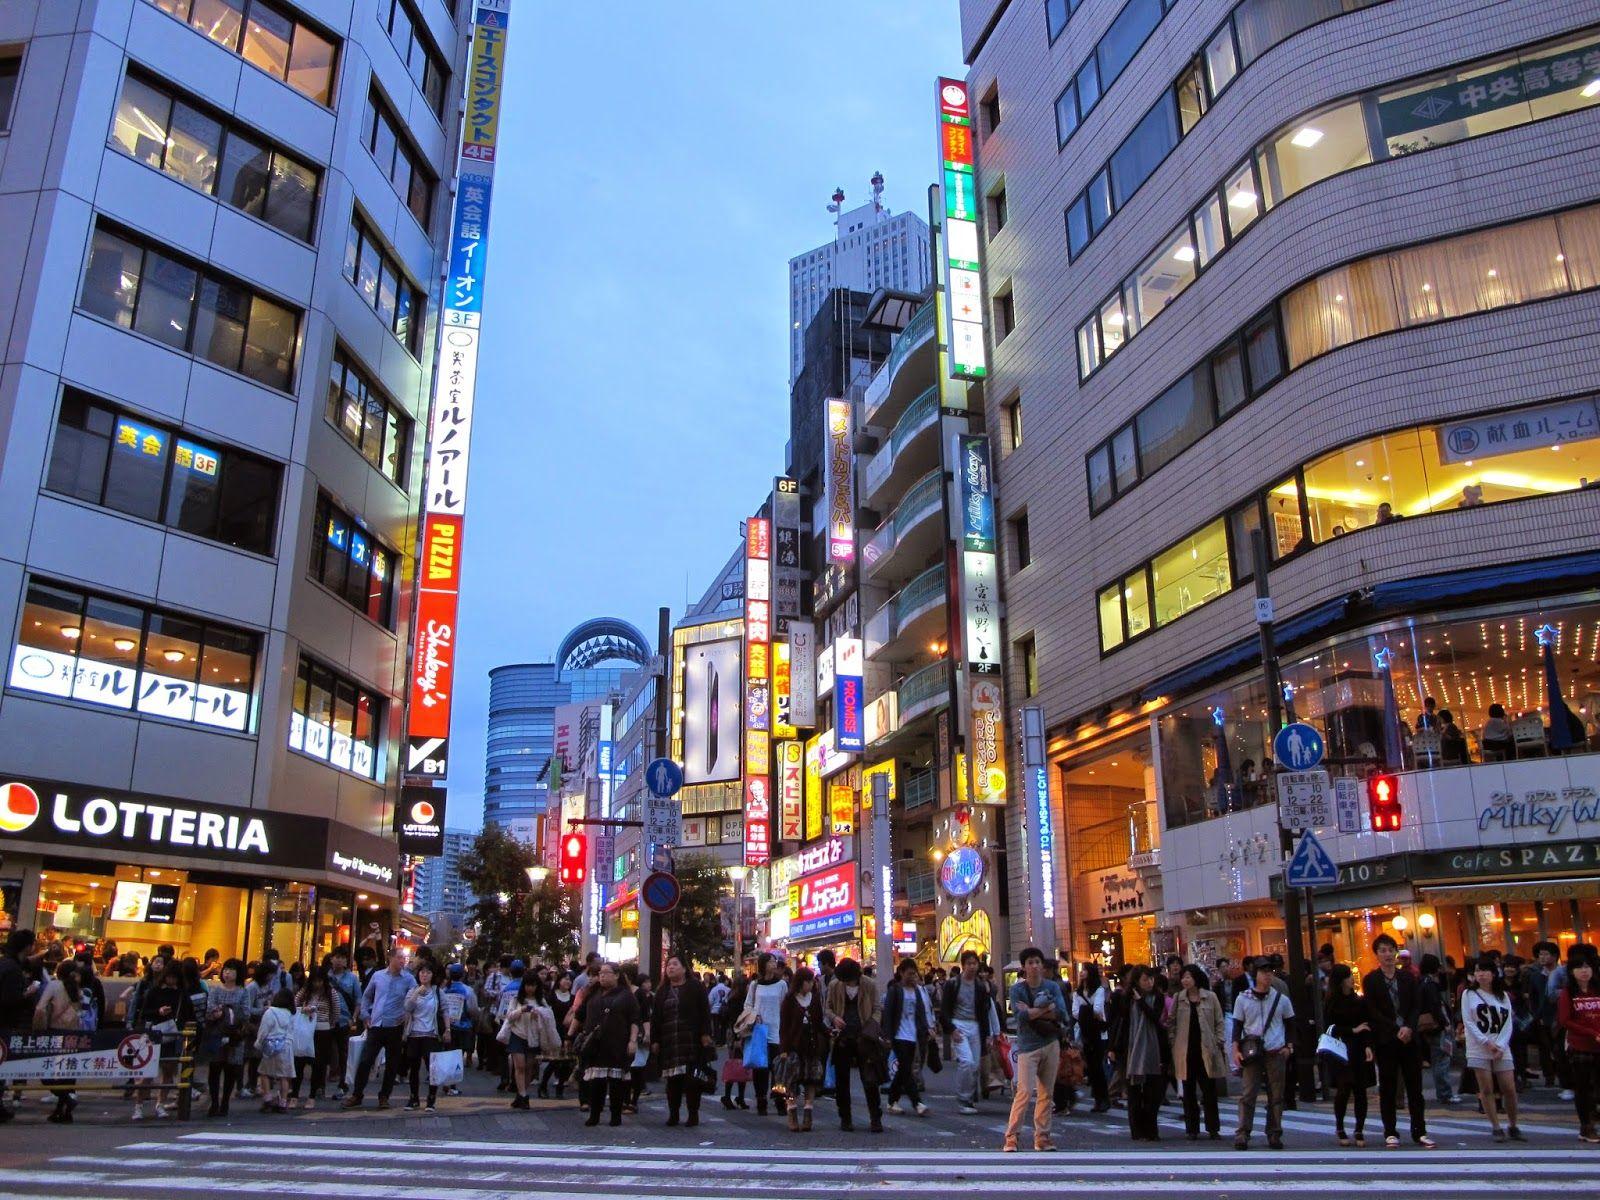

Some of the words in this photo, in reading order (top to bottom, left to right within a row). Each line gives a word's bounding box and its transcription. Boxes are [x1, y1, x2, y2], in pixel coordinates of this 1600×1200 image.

[470, 28, 502, 142] エースコンタクト
[464, 145, 494, 159] 4F
[455, 187, 484, 307] 英会話イーオン
[451, 312, 474, 325] 3F
[778, 480, 797, 493] 6F
[428, 523, 455, 580] PIZZA
[417, 619, 450, 708] Shakey's
[977, 663, 992, 673] 2F
[843, 680, 857, 734] PROMISE
[423, 758, 445, 775] B1
[1036, 768, 1046, 789] CITY
[1287, 785, 1293, 795] 8
[1312, 784, 1322, 793] 10
[785, 767, 801, 837] スピンズ
[1287, 795, 1298, 806] 12
[1310, 794, 1323, 804] 22
[1038, 790, 1049, 834] SUNSHINE
[1479, 802, 1570, 834] Milky
[52, 793, 270, 853] LOTTERIA
[403, 823, 441, 833] LOTTERIA
[650, 817, 658, 826] 12
[666, 818, 677, 827] 22
[1290, 817, 1300, 827] 10
[1312, 816, 1325, 826] 22
[665, 836, 676, 845] 22
[1041, 835, 1050, 848] TO
[41, 1057, 119, 1071] ポイ捨て禁止
